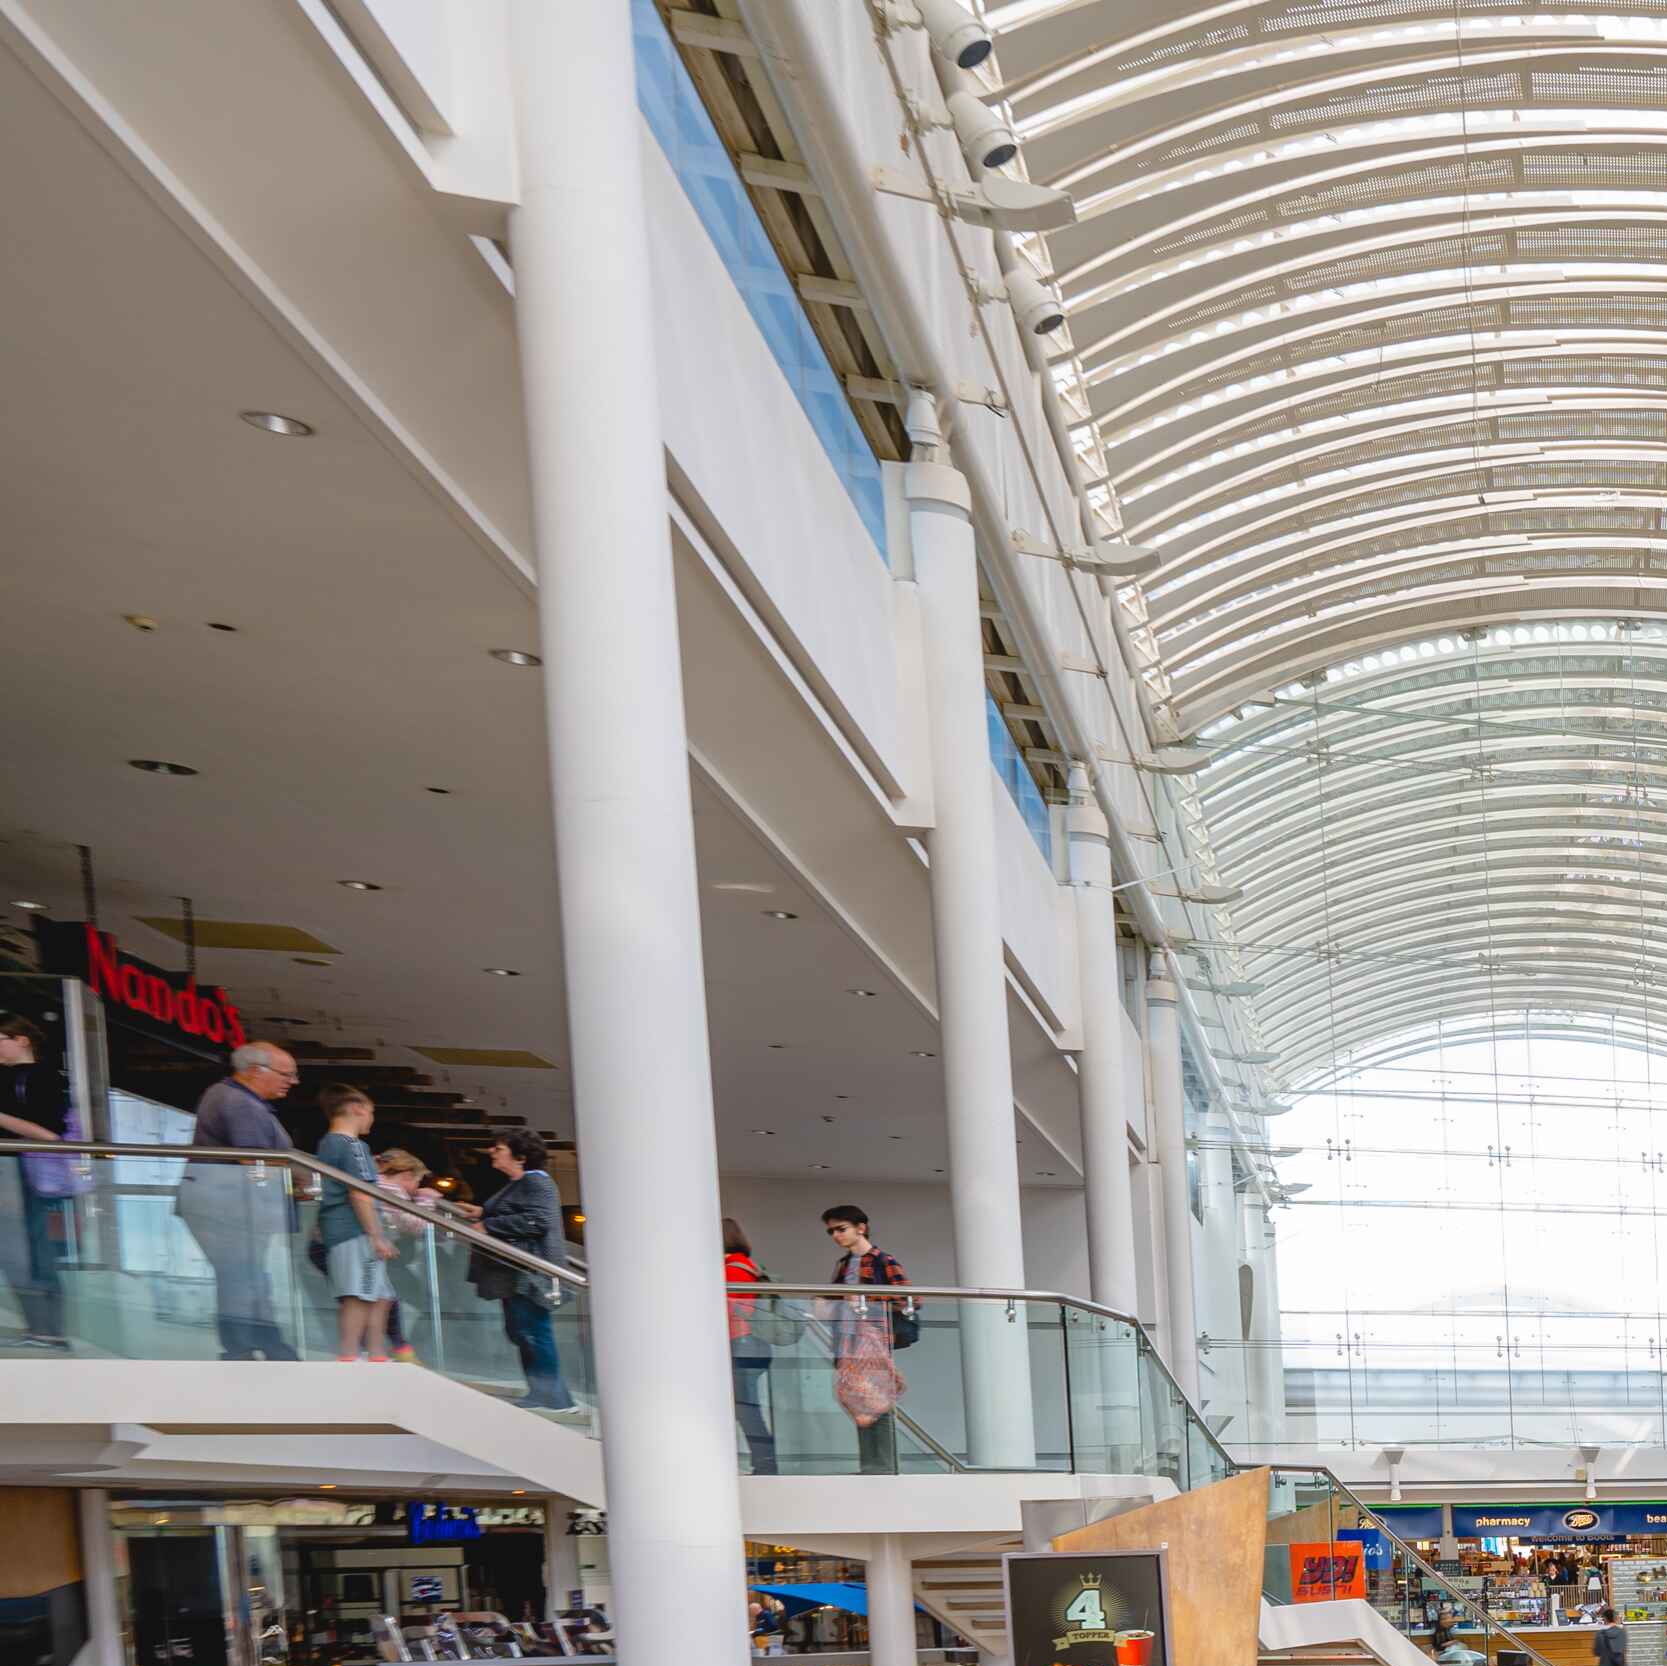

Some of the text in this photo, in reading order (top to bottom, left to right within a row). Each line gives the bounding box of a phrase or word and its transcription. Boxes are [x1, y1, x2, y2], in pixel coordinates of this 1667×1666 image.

[84, 921, 246, 1050] Nando's
[1475, 1516, 1531, 1528] pharmacy
[1066, 1587, 1107, 1630] 4
[1071, 1630, 1111, 1641] TOPPER
